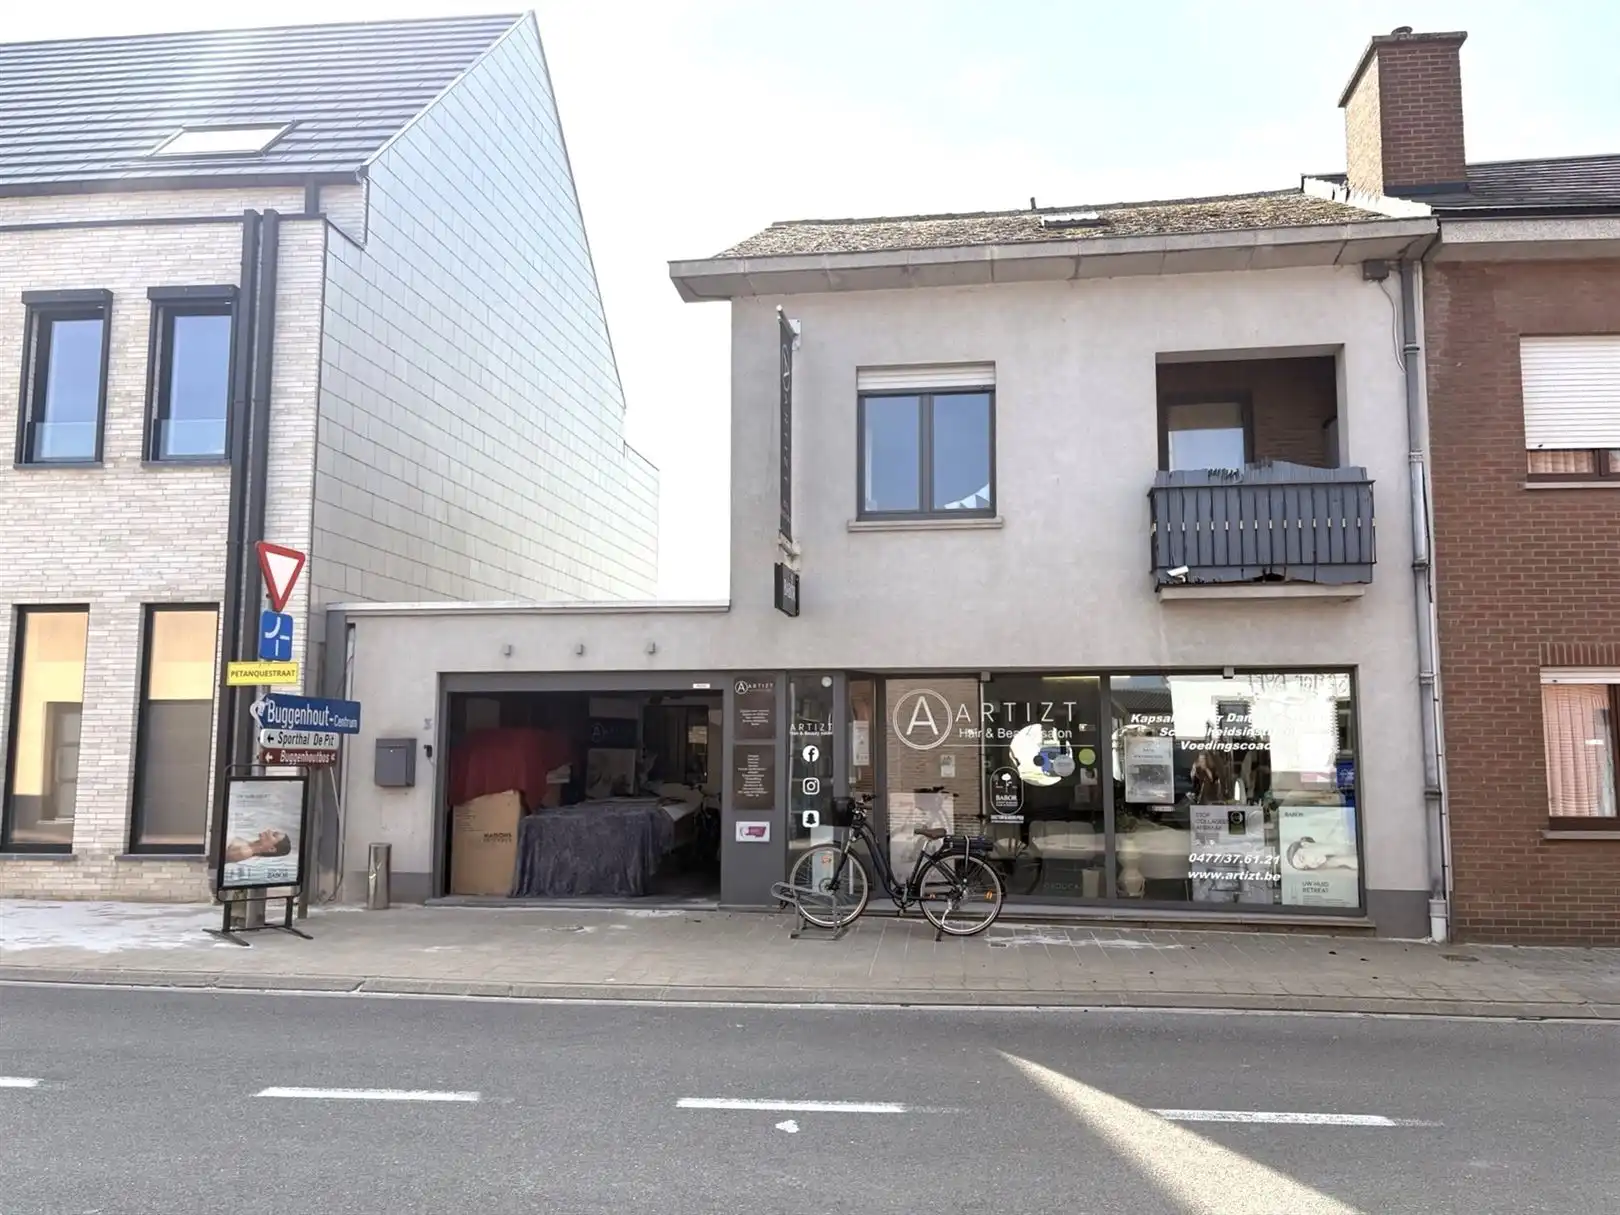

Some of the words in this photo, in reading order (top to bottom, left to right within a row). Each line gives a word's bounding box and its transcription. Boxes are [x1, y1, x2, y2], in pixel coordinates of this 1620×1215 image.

[231, 669, 296, 678] PETANQUESTRAAT
[955, 702, 1077, 722] ARTIZT
[790, 723, 833, 731] ARTIZT
[959, 727, 983, 739] Hair
[986, 727, 994, 739] &
[277, 731, 310, 747] Sporthal
[313, 734, 323, 746] De
[324, 735, 335, 746] Pit
[1181, 740, 1273, 752] Voedingscoac
[1188, 852, 1281, 865] 0477/37.61.21
[1187, 870, 1281, 882] www.artizt.be
